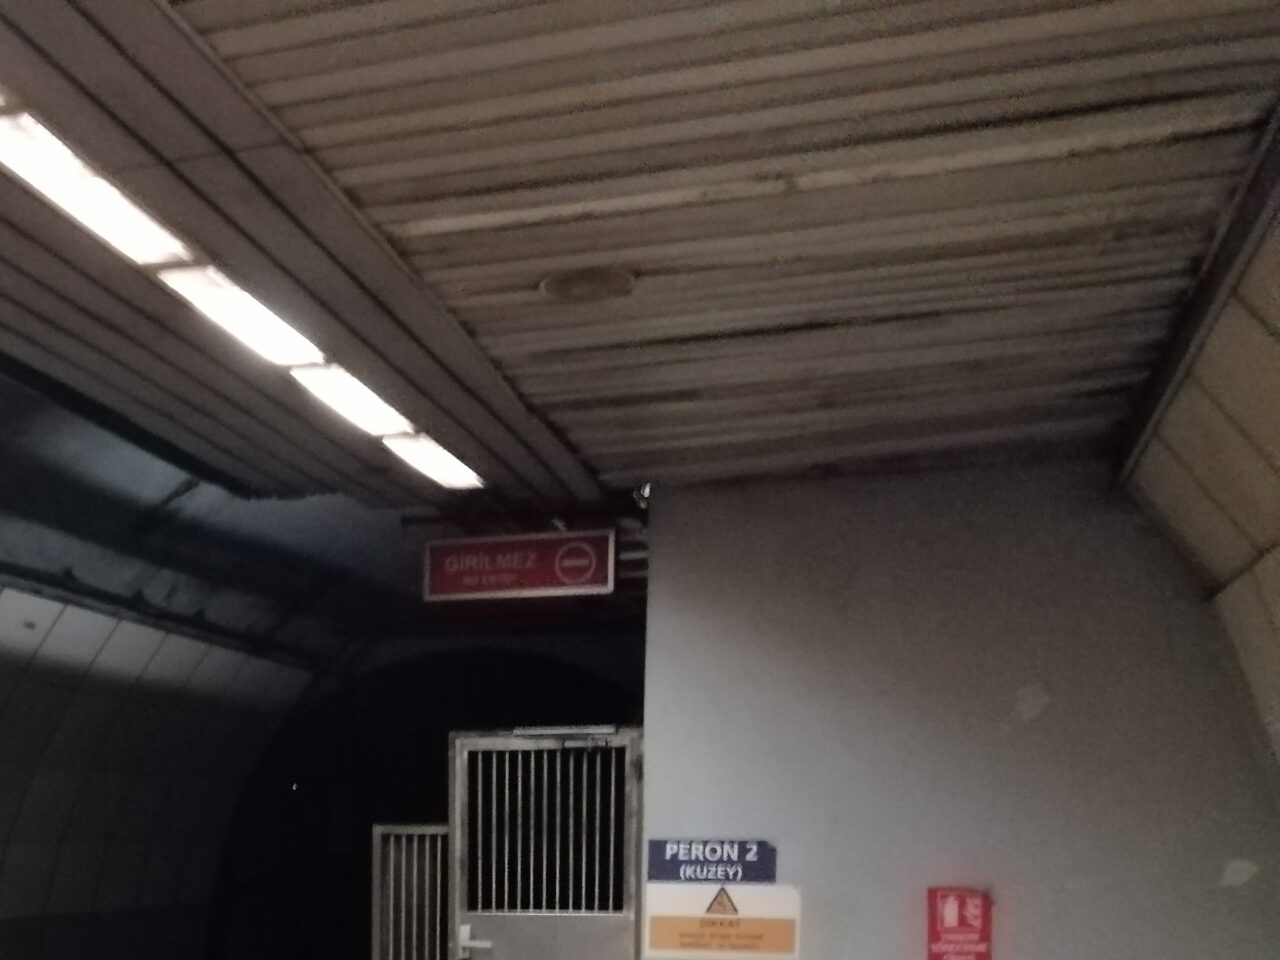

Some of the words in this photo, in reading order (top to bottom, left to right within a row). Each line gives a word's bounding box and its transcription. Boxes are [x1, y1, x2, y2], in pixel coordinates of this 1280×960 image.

[665, 841, 738, 861] PERON
[745, 841, 758, 861] 2
[679, 863, 743, 881] (KUZEY)
